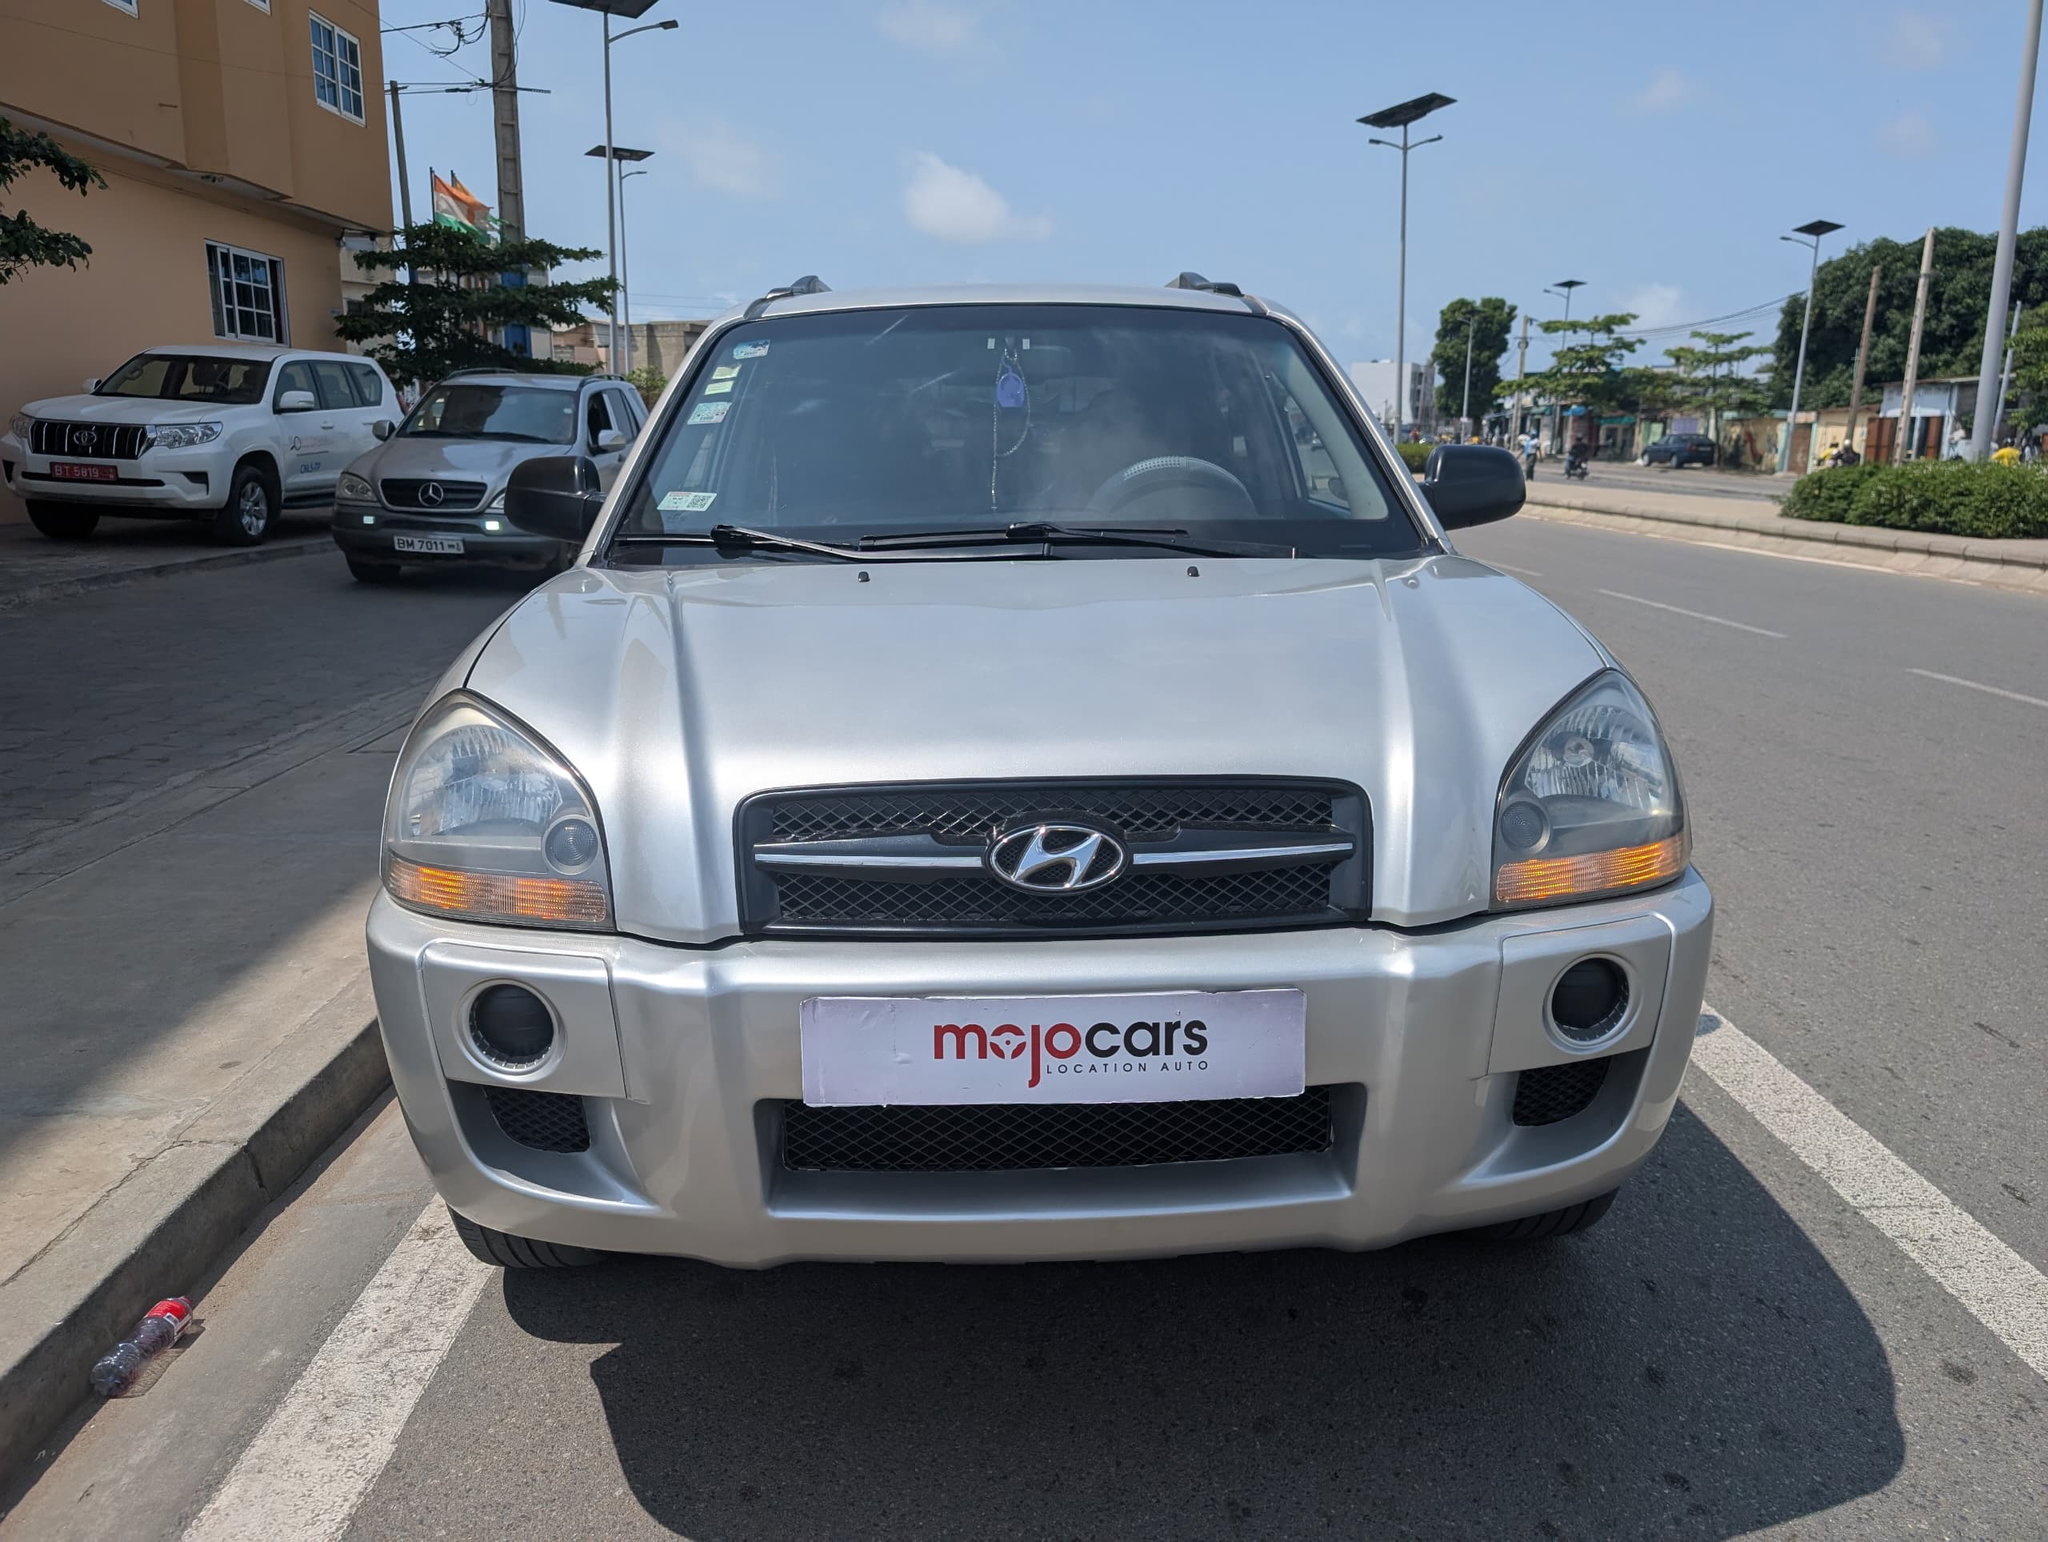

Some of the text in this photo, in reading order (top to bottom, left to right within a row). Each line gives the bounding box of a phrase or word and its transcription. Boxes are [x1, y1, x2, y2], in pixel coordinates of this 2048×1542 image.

[54, 464, 70, 477] BT
[397, 538, 415, 549] BM
[417, 540, 445, 551] 7011
[933, 1019, 1208, 1088] mojocars
[1046, 1060, 1208, 1074] LOCATION AUTO
